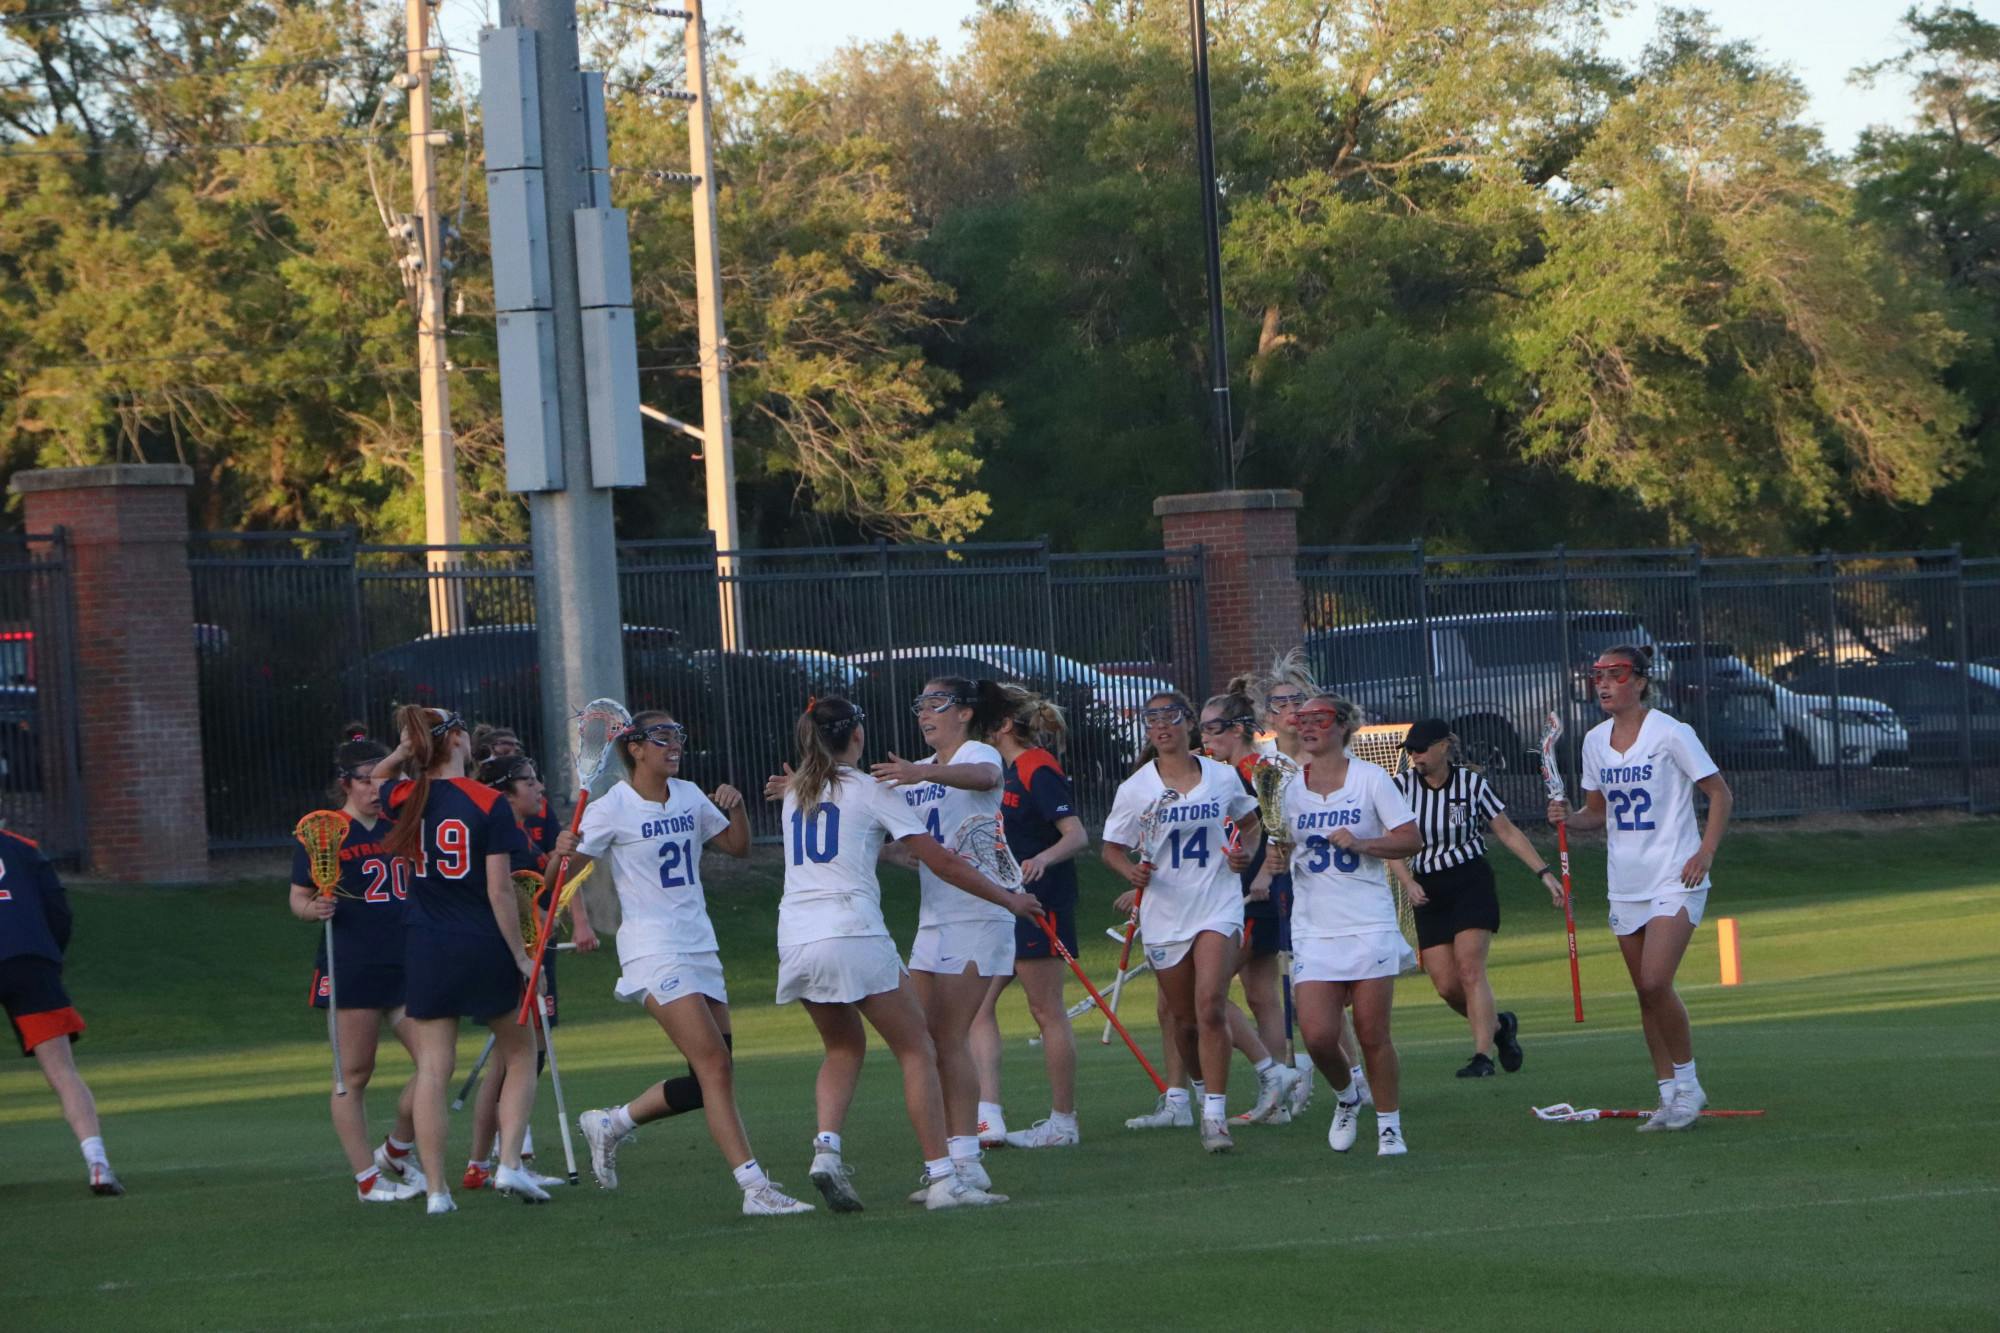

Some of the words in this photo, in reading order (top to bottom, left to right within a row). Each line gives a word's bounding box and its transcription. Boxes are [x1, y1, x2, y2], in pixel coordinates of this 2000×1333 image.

[1600, 765, 1653, 784] GATORS
[641, 815, 695, 838] GATORS
[1159, 803, 1220, 823] GATORS
[1297, 808, 1362, 829] GATORS
[1608, 788, 1656, 831] 22
[791, 802, 840, 866] 10
[1168, 826, 1210, 868] 14
[362, 856, 409, 903] 20
[658, 839, 695, 888] 21
